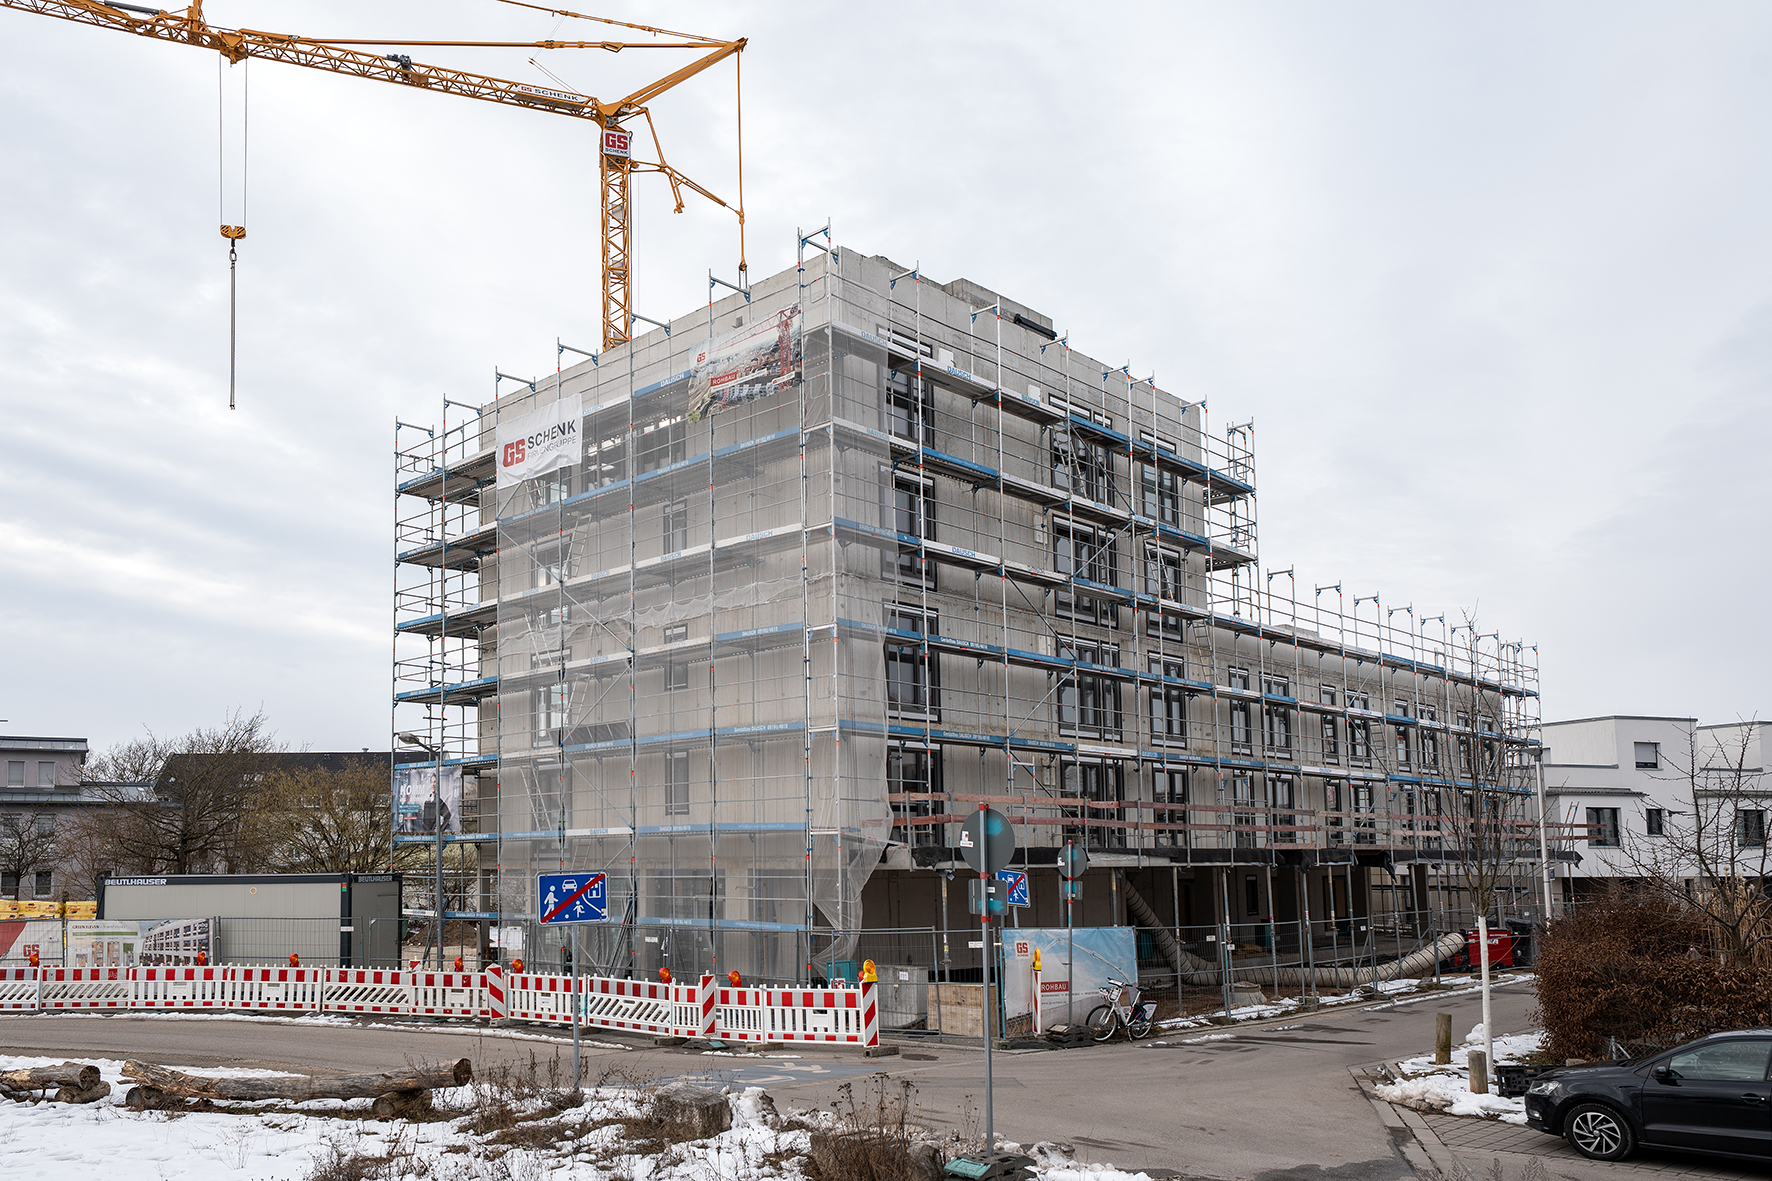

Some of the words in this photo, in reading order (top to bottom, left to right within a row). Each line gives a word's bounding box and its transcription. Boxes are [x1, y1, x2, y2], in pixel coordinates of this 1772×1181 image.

[534, 88, 579, 101] SCHENK
[605, 132, 628, 150] GS
[605, 147, 629, 155] SCHENK
[697, 352, 706, 362] GS
[947, 365, 972, 381] DAUSCH
[660, 372, 685, 387] DAUSCH
[527, 419, 576, 449] SCHENK
[502, 438, 526, 468] GS
[746, 529, 773, 541] DAUSCH
[952, 546, 976, 558] DAUSCH
[104, 878, 167, 886] BEUTLHAUSER
[23, 944, 40, 958] GS
[1016, 942, 1029, 954] GS
[1041, 983, 1067, 991] ROHBAU
